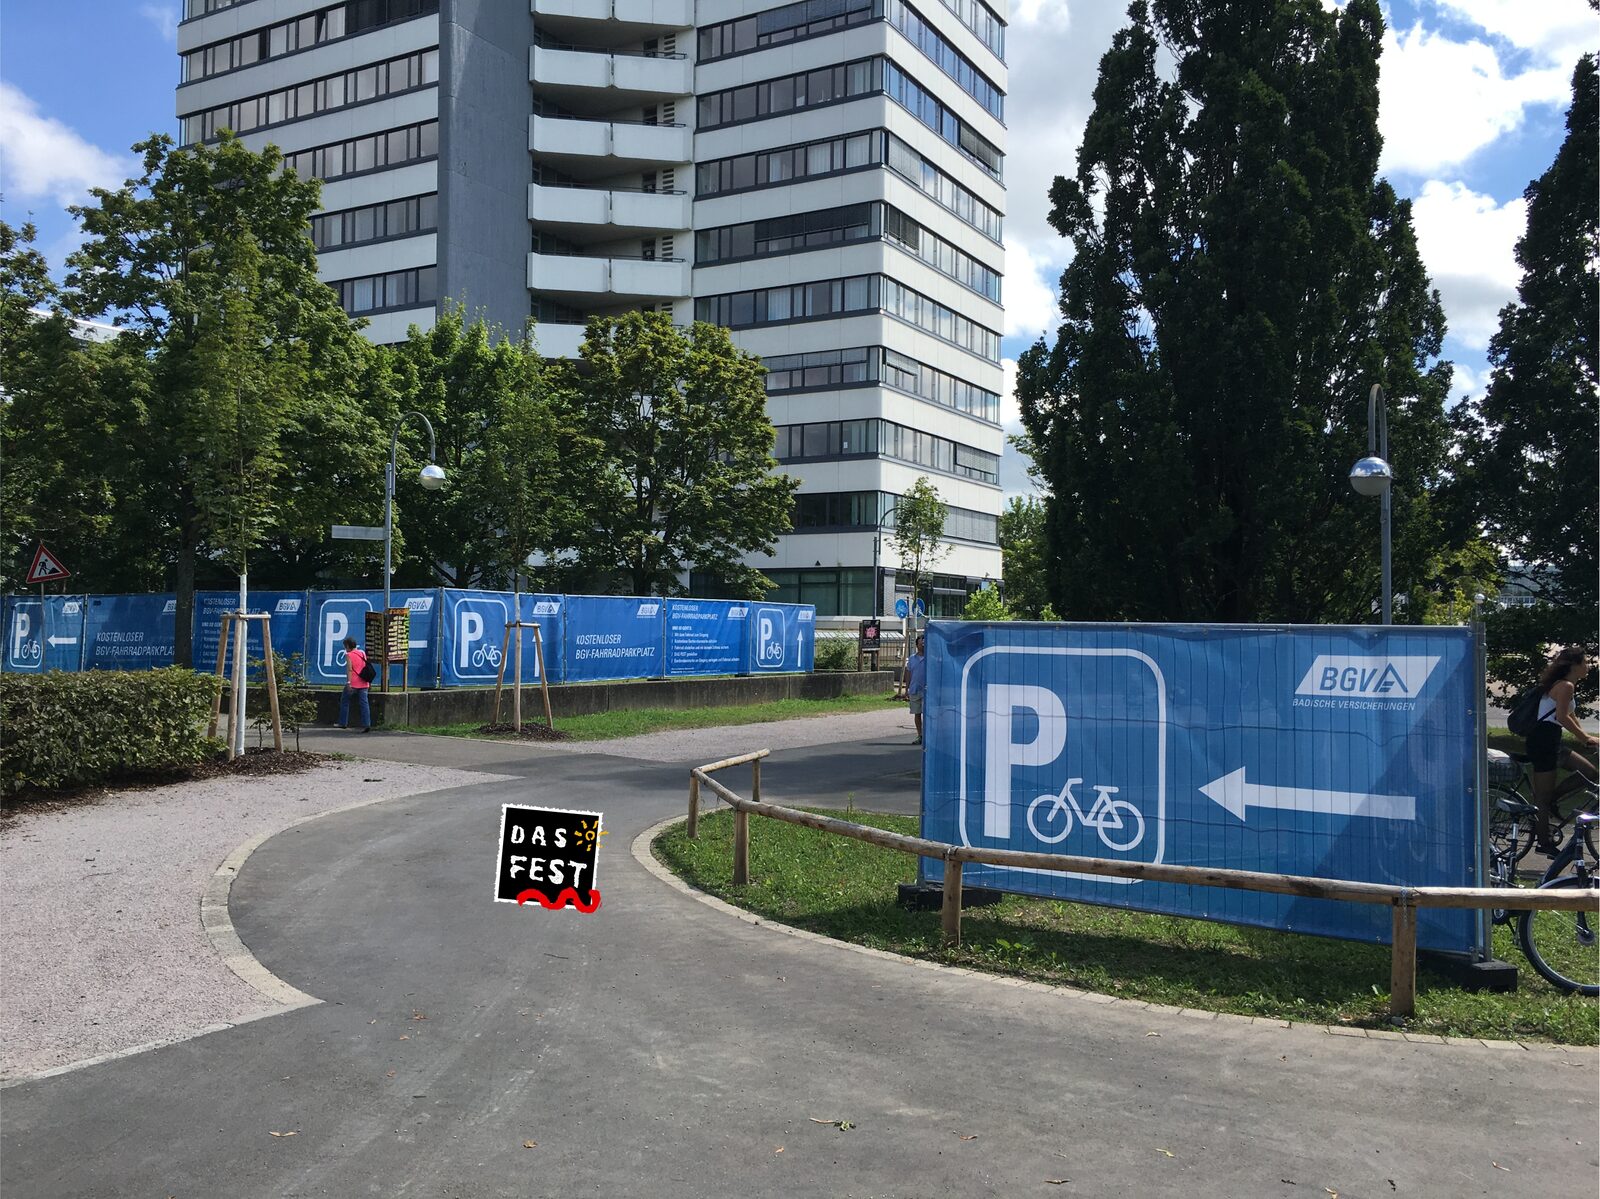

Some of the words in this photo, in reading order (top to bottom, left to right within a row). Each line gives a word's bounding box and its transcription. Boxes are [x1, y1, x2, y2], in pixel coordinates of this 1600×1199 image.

[13, 613, 31, 659] P
[96, 632, 145, 642] KOSTENLOSER
[324, 612, 349, 667] P
[460, 612, 484, 668] P
[576, 634, 622, 645] KOSTENLOSER
[760, 618, 773, 660] P
[95, 645, 176, 656] BGV-FAHRRADPARKPLA
[576, 646, 656, 660] BGV-FAHRRADPARKPLATZ
[1292, 698, 1336, 708] BADISCHE
[1338, 699, 1416, 711] VERSICHERUNGEN
[983, 683, 1067, 839] P
